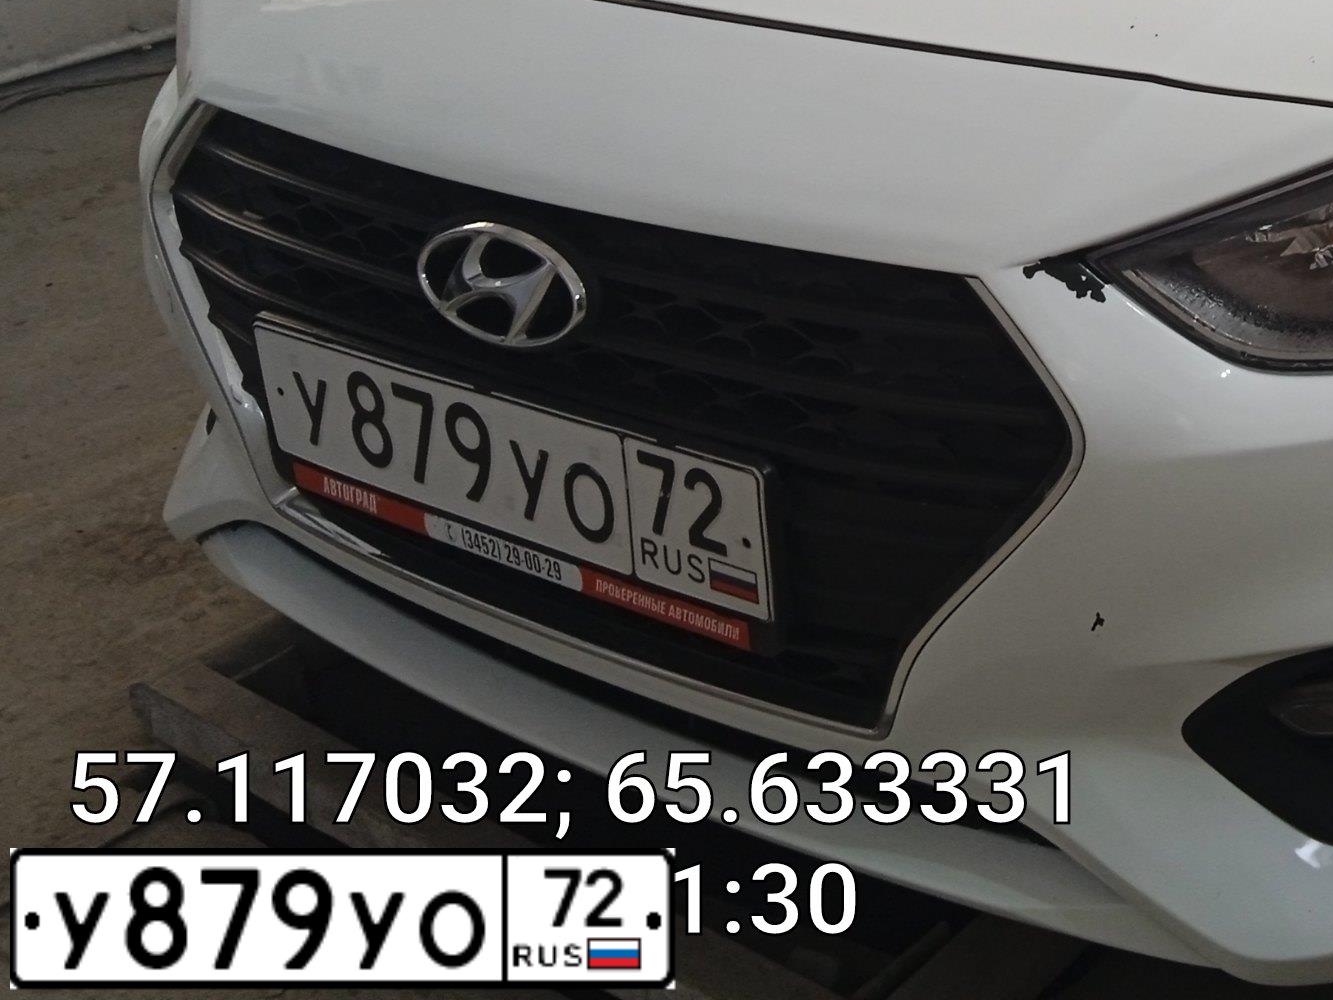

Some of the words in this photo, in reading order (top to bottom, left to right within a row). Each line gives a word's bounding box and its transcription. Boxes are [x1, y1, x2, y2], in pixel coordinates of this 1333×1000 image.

[323, 476, 378, 514] АВТОГРАД
[637, 450, 727, 555] 72
[504, 543, 562, 582] 29-00-29
[641, 537, 705, 583] RUS
[596, 579, 666, 615] ПРОВЕРЕННЫЕ
[668, 605, 740, 641] АВТОМОБИЛИ
